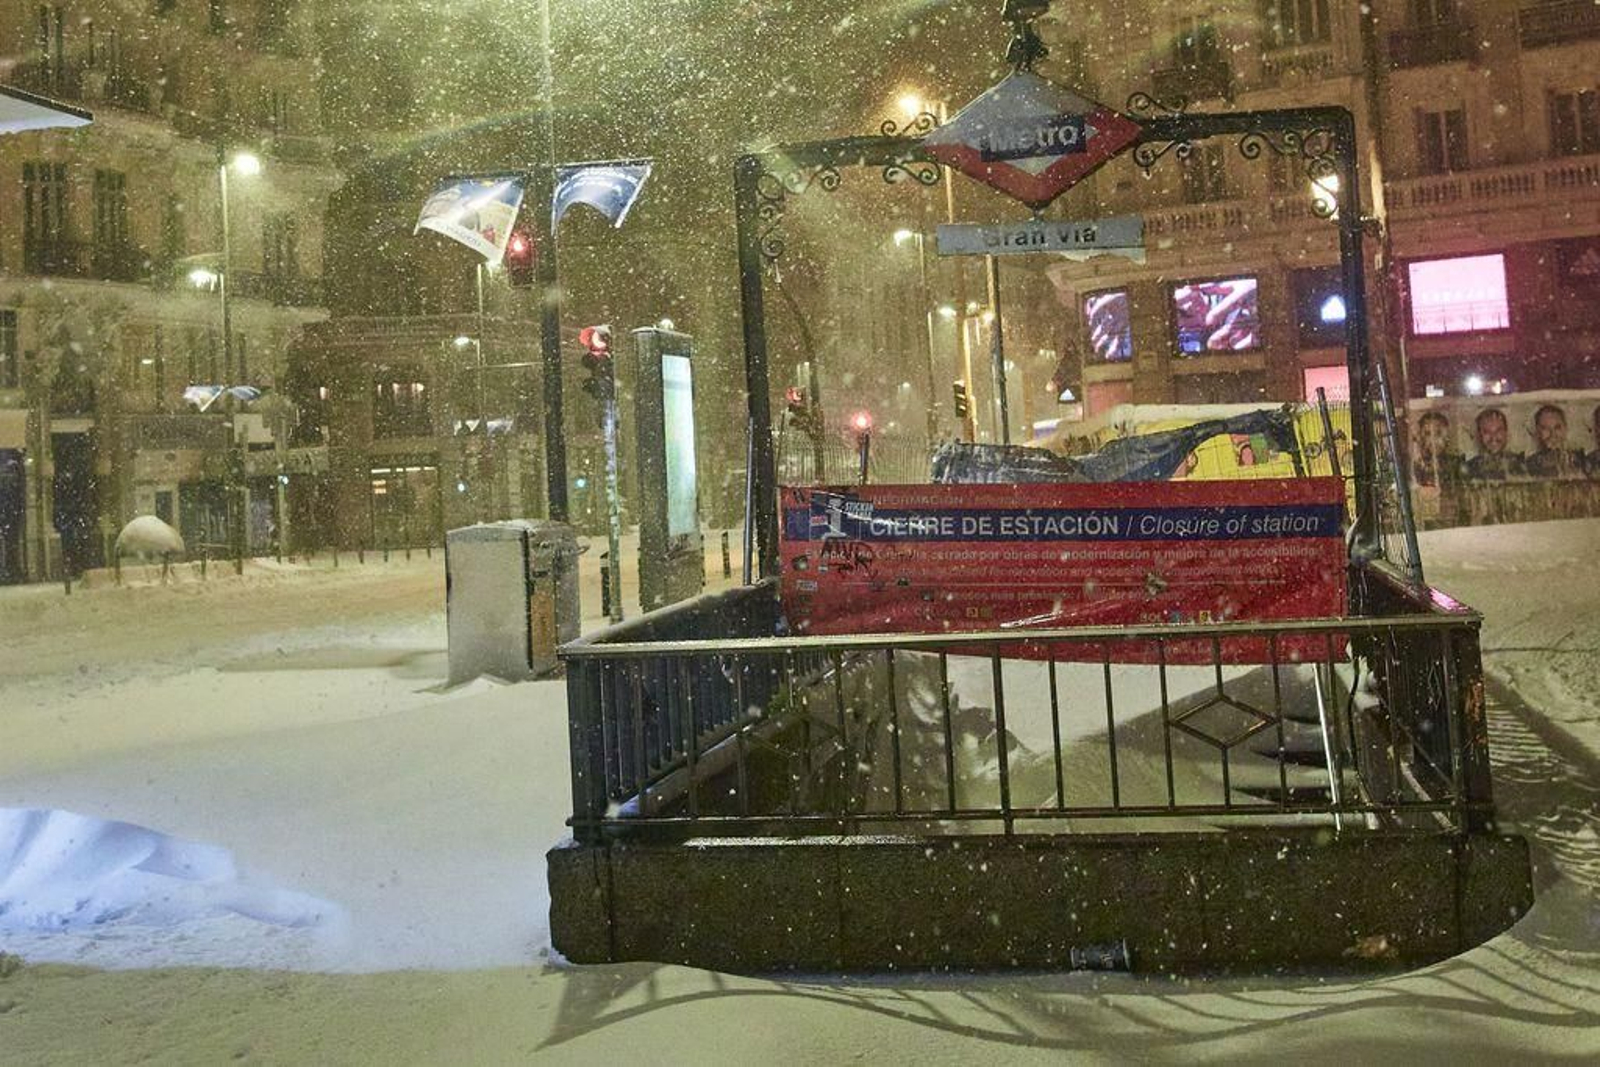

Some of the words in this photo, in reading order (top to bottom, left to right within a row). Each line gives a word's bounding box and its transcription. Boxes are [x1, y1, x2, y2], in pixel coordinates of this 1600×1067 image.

[870, 517, 954, 536] CIERRE
[962, 516, 994, 535] DE
[1000, 511, 1119, 535] ESTACIÓN
[1125, 515, 1134, 537] /
[1139, 513, 1220, 535] Closure
[1226, 514, 1248, 534] of
[1251, 514, 1320, 533] station
